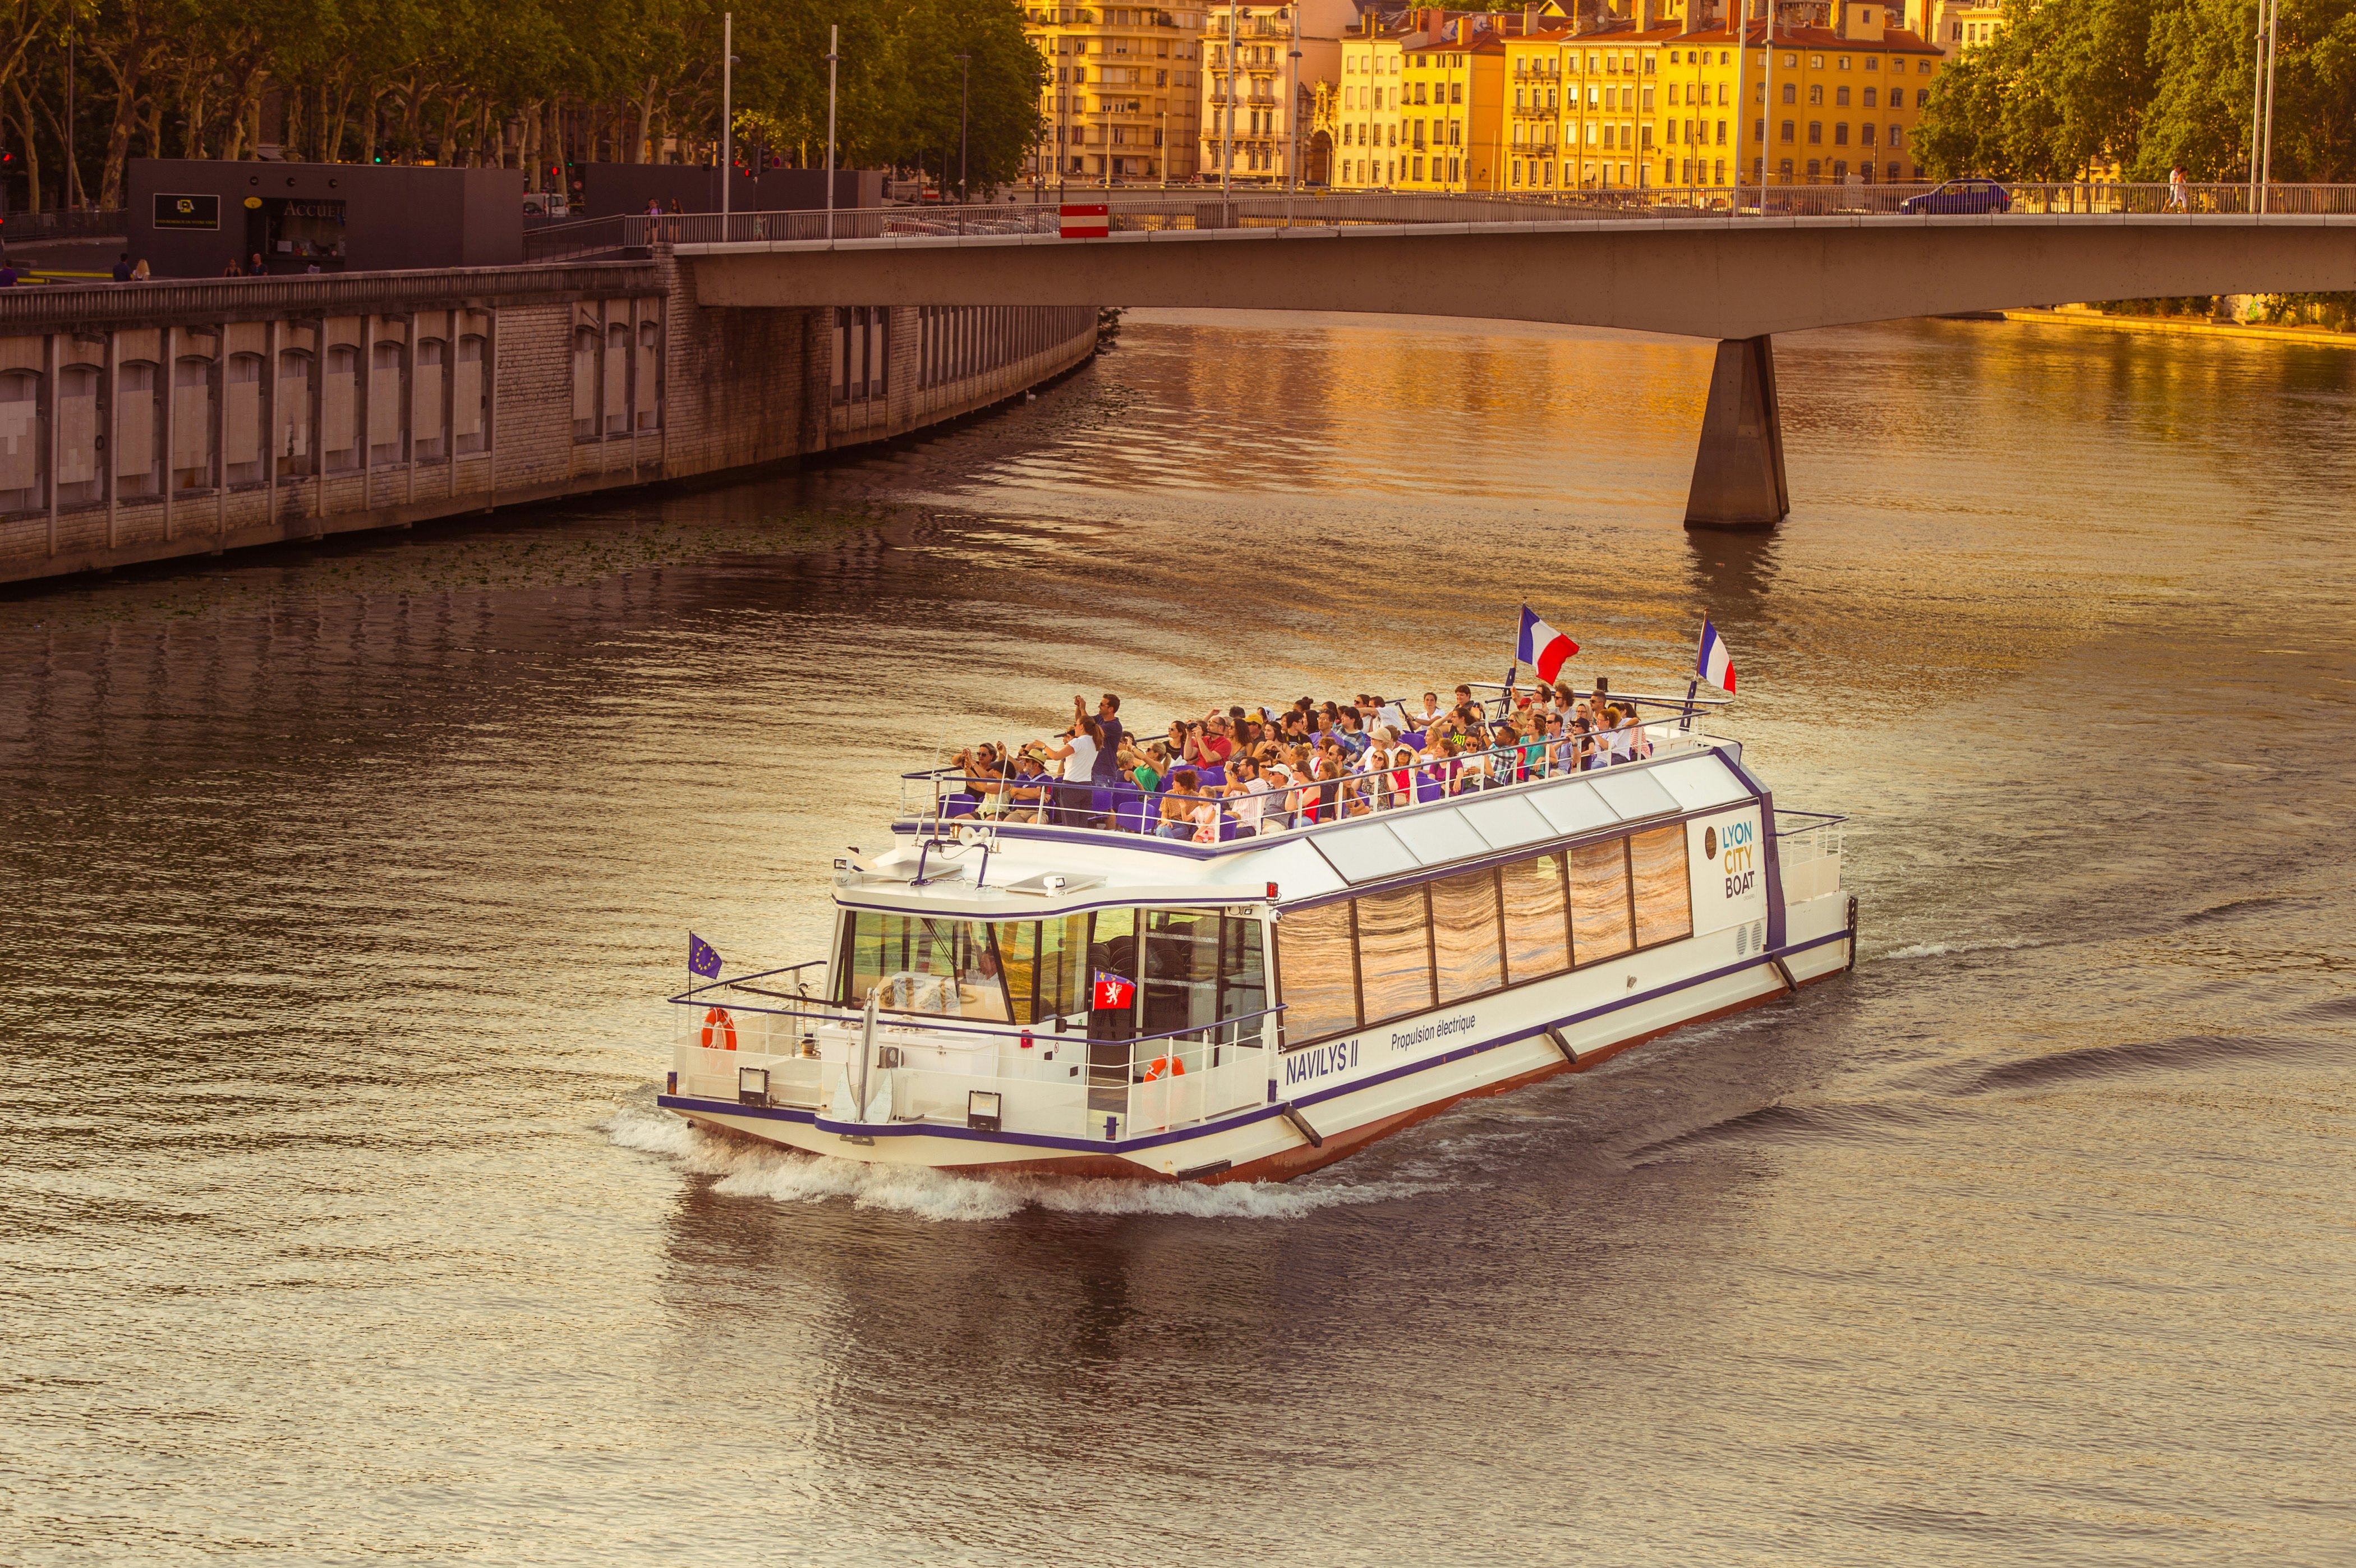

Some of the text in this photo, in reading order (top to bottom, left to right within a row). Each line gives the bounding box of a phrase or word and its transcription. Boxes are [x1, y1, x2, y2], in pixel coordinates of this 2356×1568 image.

[1723, 821, 1752, 848] LYON
[1724, 844, 1752, 875] CITY
[1725, 871, 1755, 899] BOAT
[1392, 1015, 1475, 1051] Propulsion électrique
[1286, 1040, 1358, 1086] NAVILYS II
